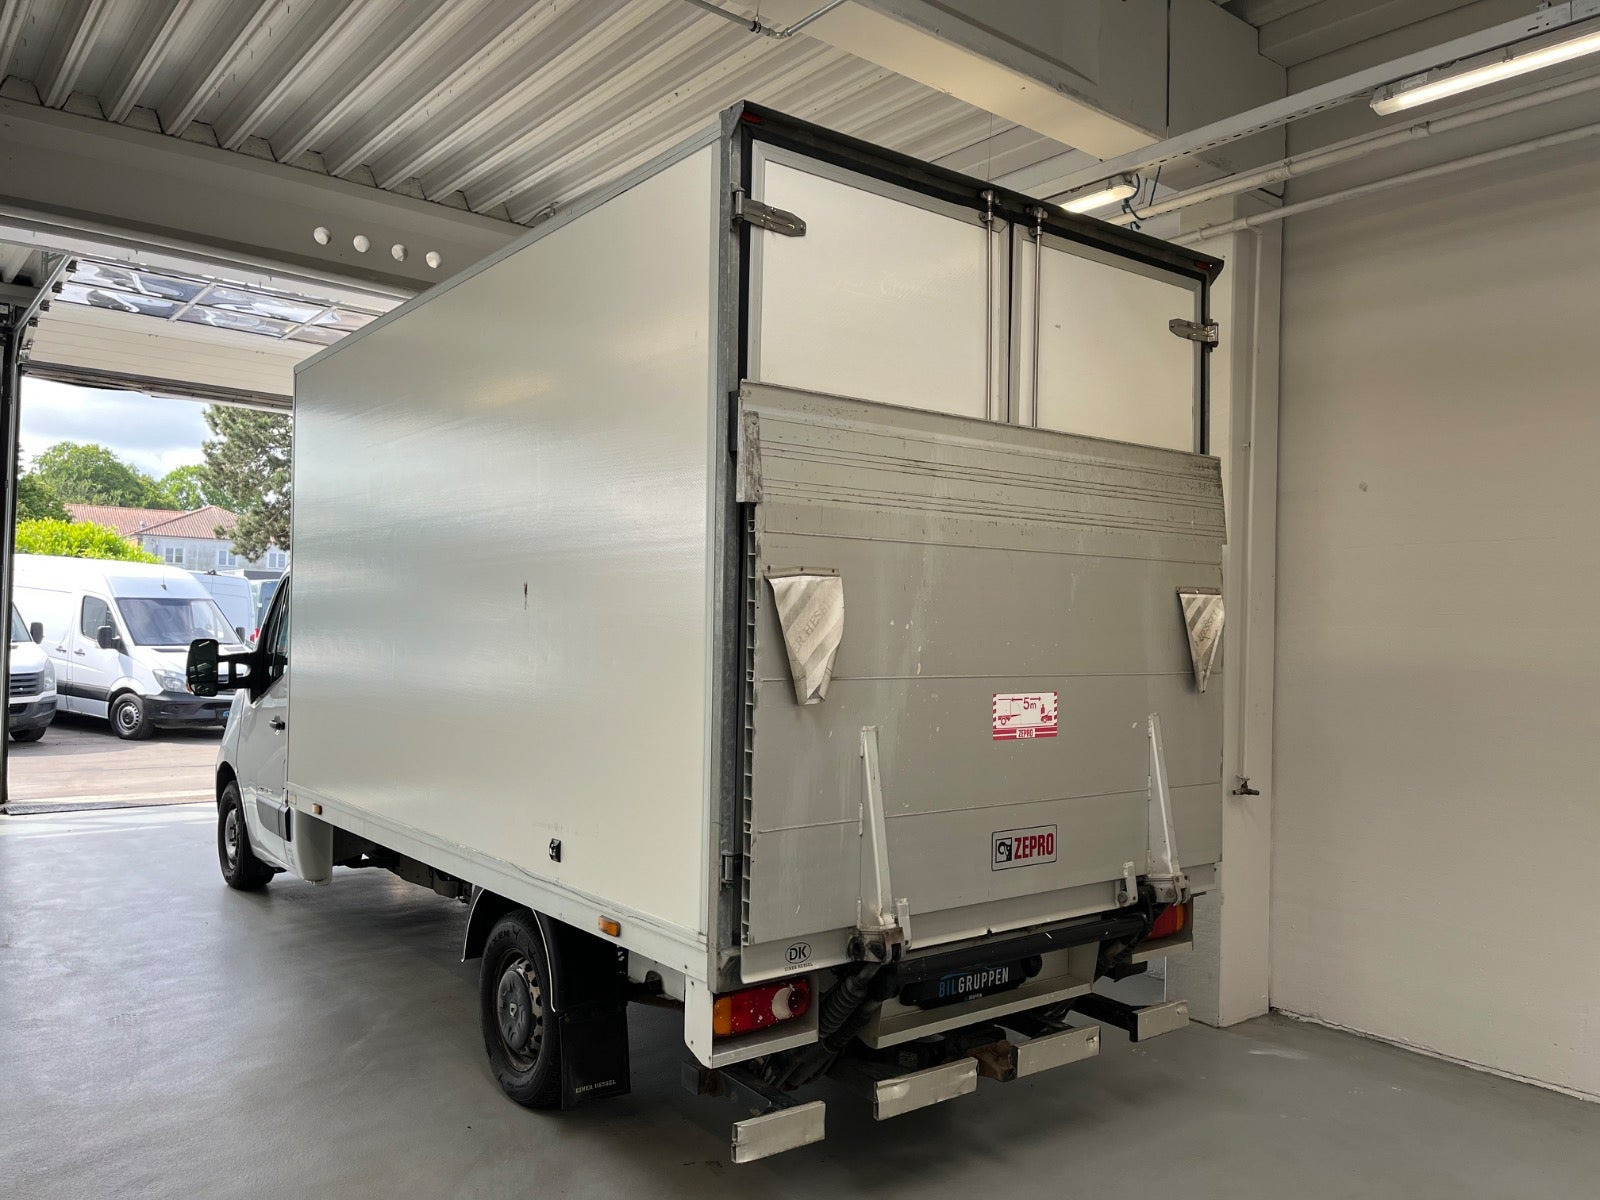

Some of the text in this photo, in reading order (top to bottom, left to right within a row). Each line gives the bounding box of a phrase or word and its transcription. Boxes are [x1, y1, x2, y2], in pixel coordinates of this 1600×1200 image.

[1023, 696, 1037, 710] 5m
[1018, 728, 1034, 738] ZEPRO
[1014, 832, 1054, 860] ZEPRO
[789, 945, 807, 961] DK
[939, 966, 1009, 998] BILGRUPPEN
